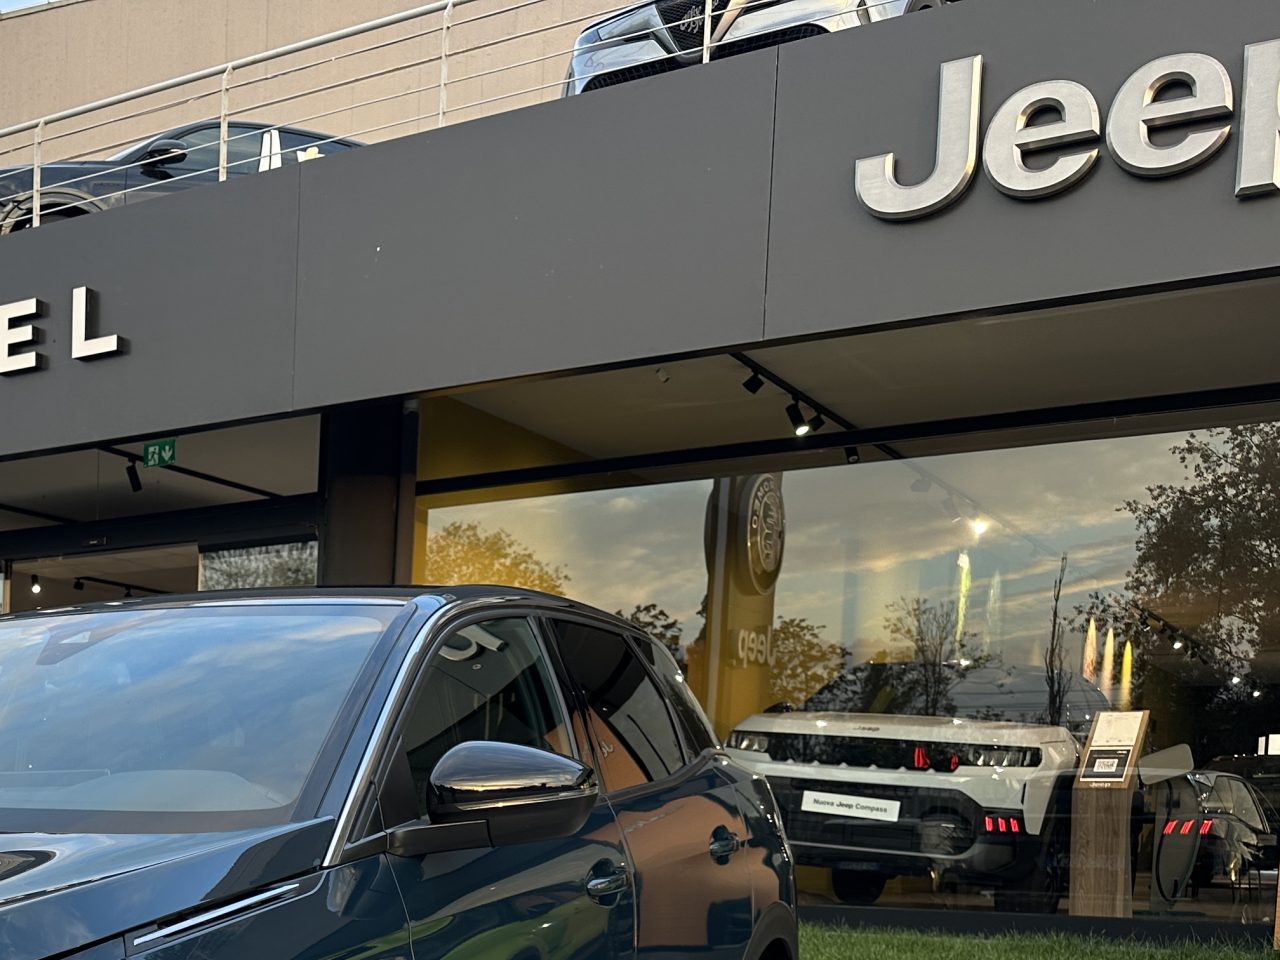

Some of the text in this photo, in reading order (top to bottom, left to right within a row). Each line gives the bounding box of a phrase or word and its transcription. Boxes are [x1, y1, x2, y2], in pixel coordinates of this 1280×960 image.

[813, 798, 888, 813] Nuova Jeep Compass
